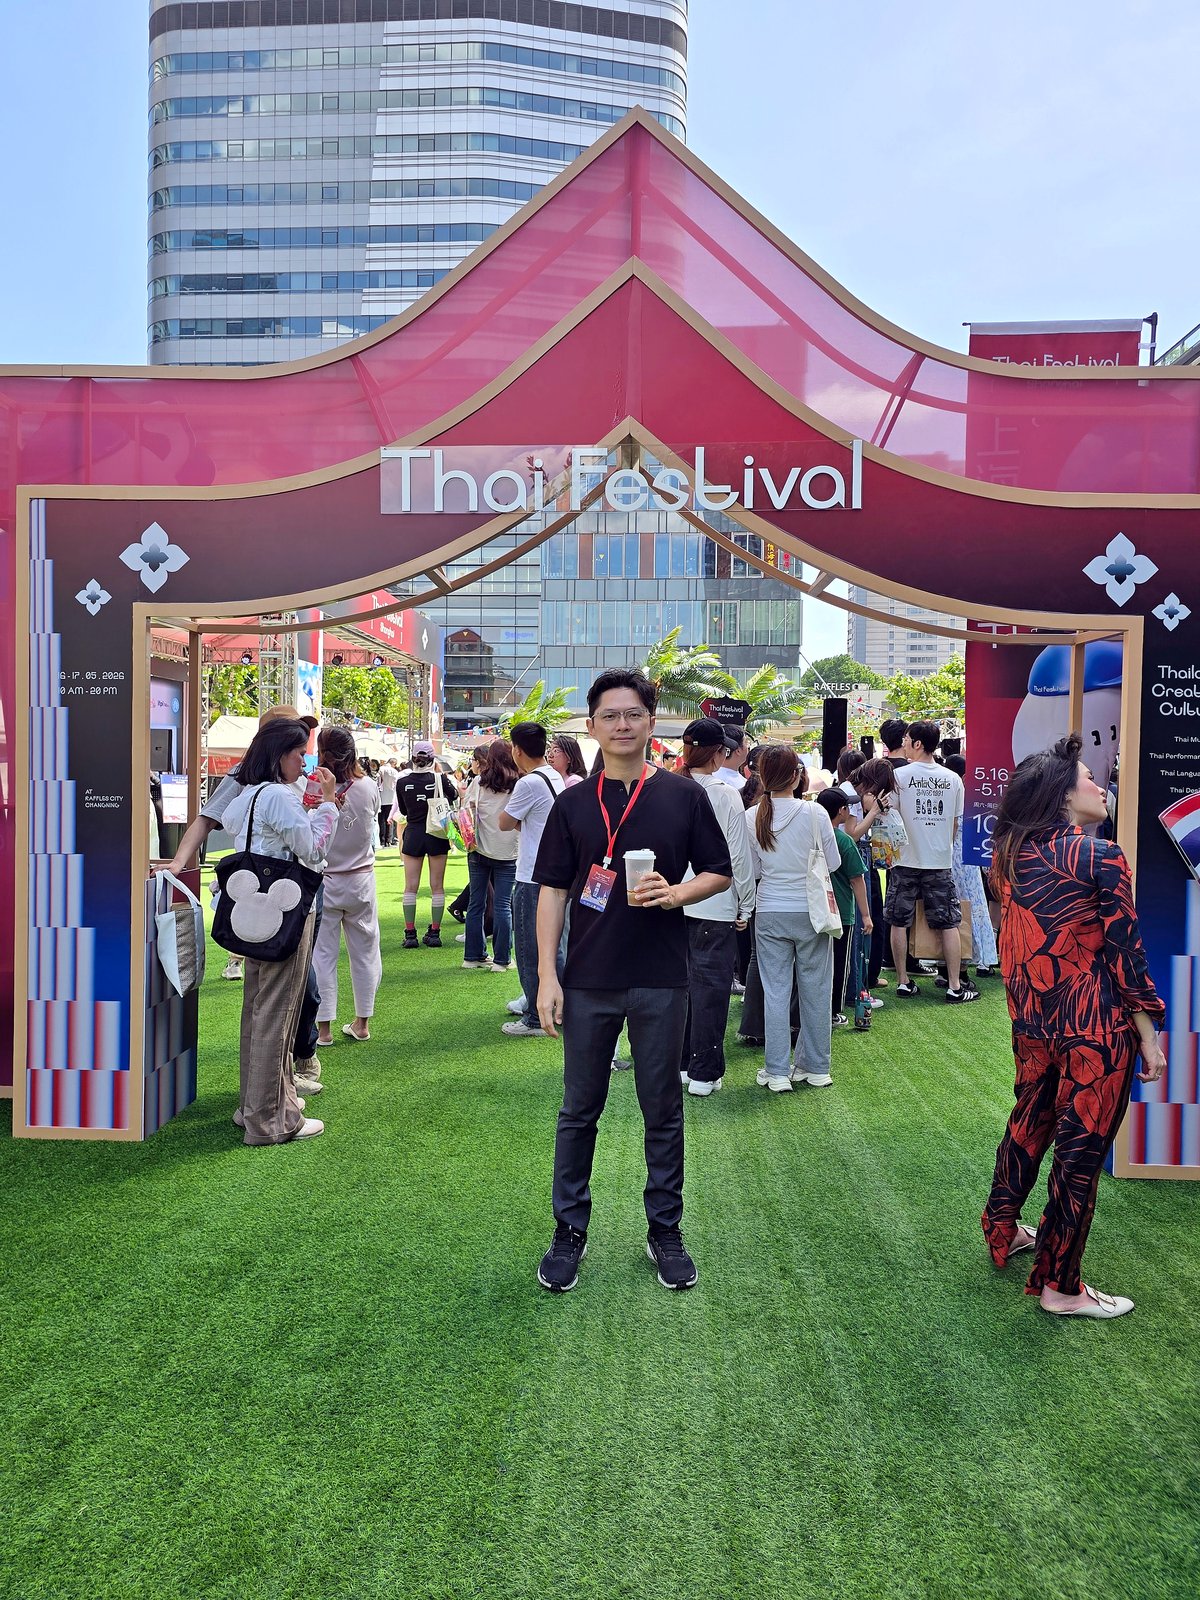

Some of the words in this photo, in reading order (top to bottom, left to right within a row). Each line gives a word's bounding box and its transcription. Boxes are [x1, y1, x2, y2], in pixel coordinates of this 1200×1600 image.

[380, 448, 544, 513] Thai
[571, 439, 863, 512] Festival
[67, 686, 84, 695] AM
[89, 686, 101, 695] 20
[102, 686, 118, 695] PM
[814, 682, 851, 691] RAFFLES
[851, 682, 872, 691] CY
[708, 703, 722, 712] Thai
[721, 704, 744, 713] Festival
[974, 767, 1010, 781] 5.16
